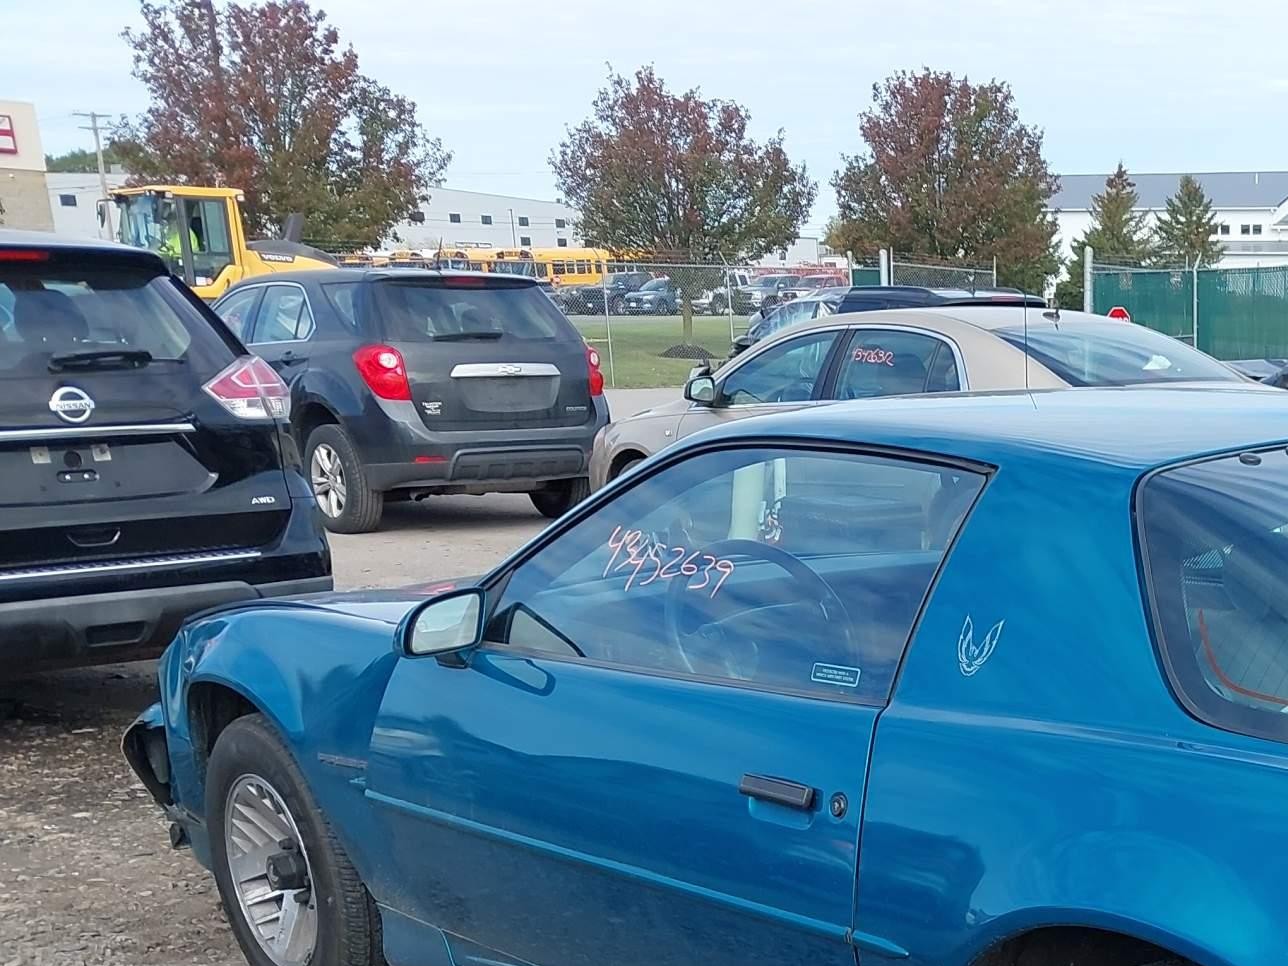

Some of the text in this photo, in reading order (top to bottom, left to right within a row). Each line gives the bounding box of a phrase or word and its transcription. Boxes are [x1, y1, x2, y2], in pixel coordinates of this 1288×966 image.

[260, 253, 294, 262] VOLVO
[56, 401, 91, 410] NISSAN
[251, 495, 276, 504] AWD
